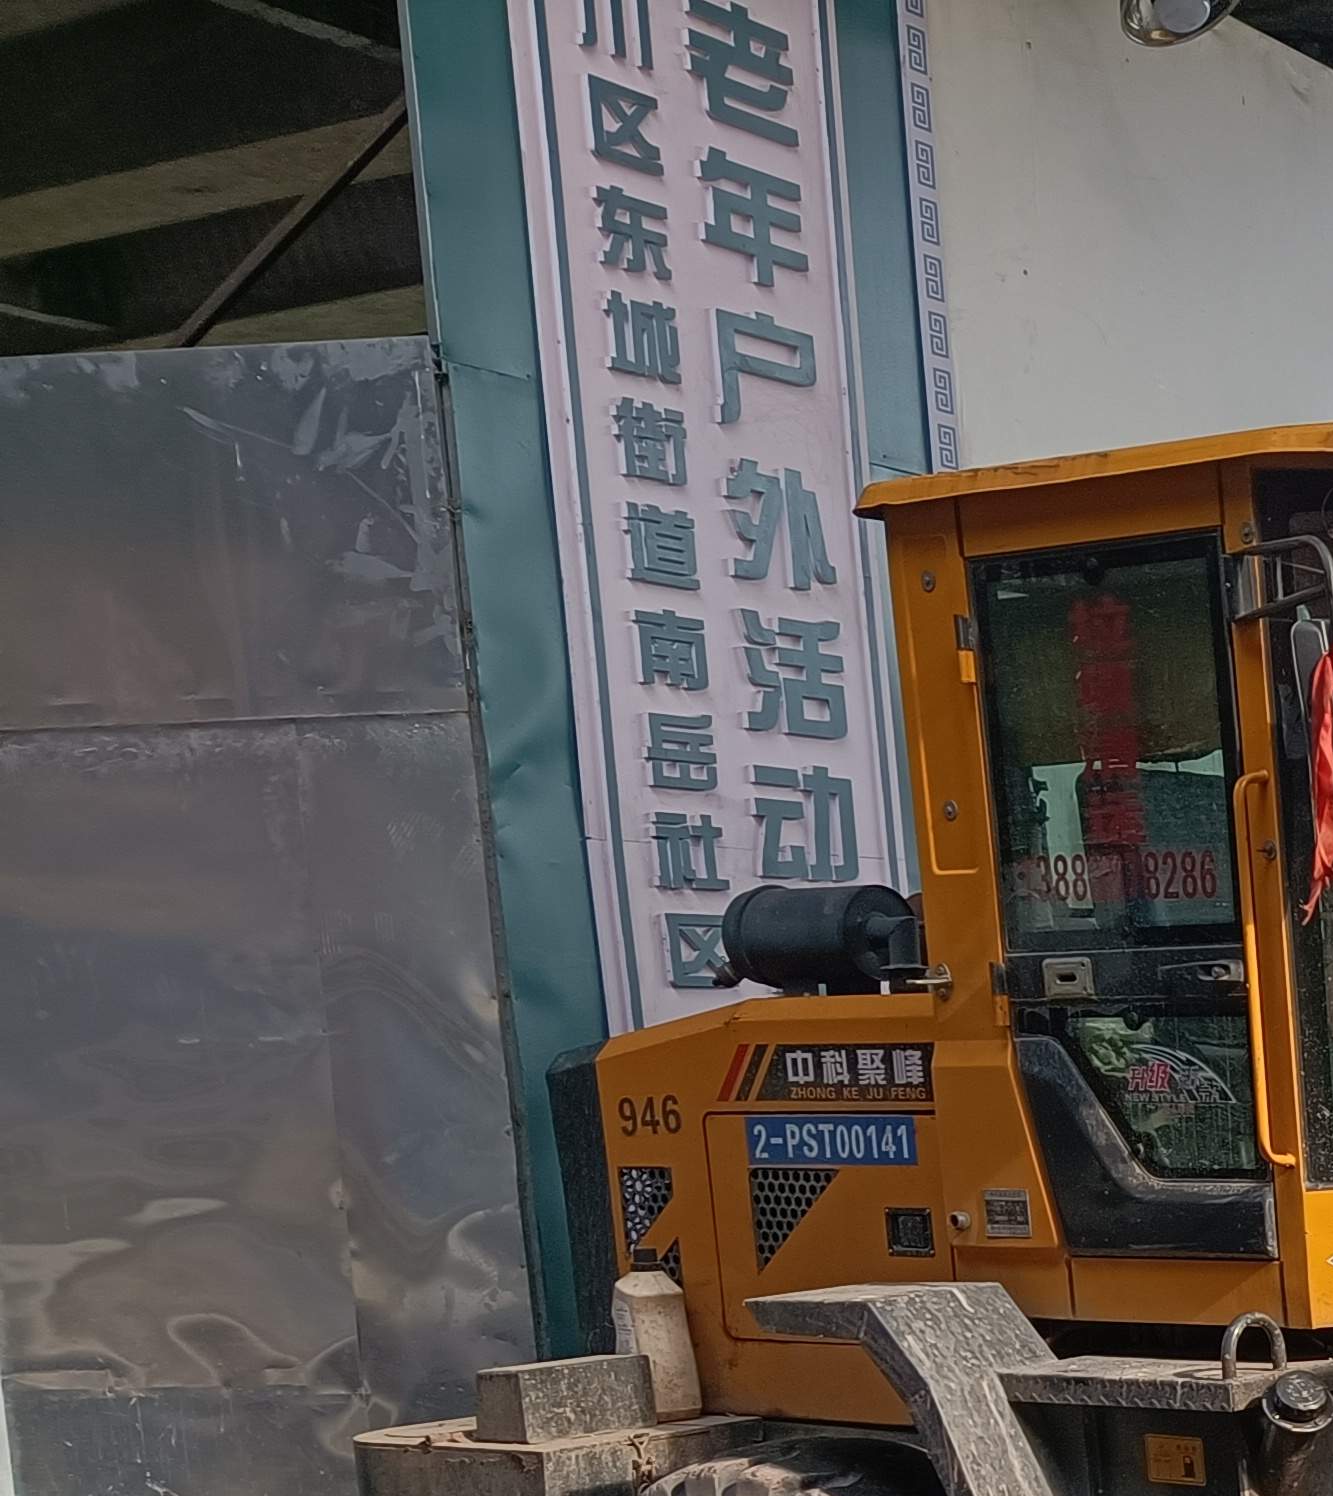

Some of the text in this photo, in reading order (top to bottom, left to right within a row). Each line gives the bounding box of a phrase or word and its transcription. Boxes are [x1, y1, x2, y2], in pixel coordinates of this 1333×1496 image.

[686, 0, 859, 882] 老年户外活动
[785, 1049, 925, 1085] 中科聚峰
[790, 1087, 927, 1099] ZHONG KE JU FENG
[618, 1094, 682, 1137] 946
[753, 1123, 910, 1159] 2-PST00141
